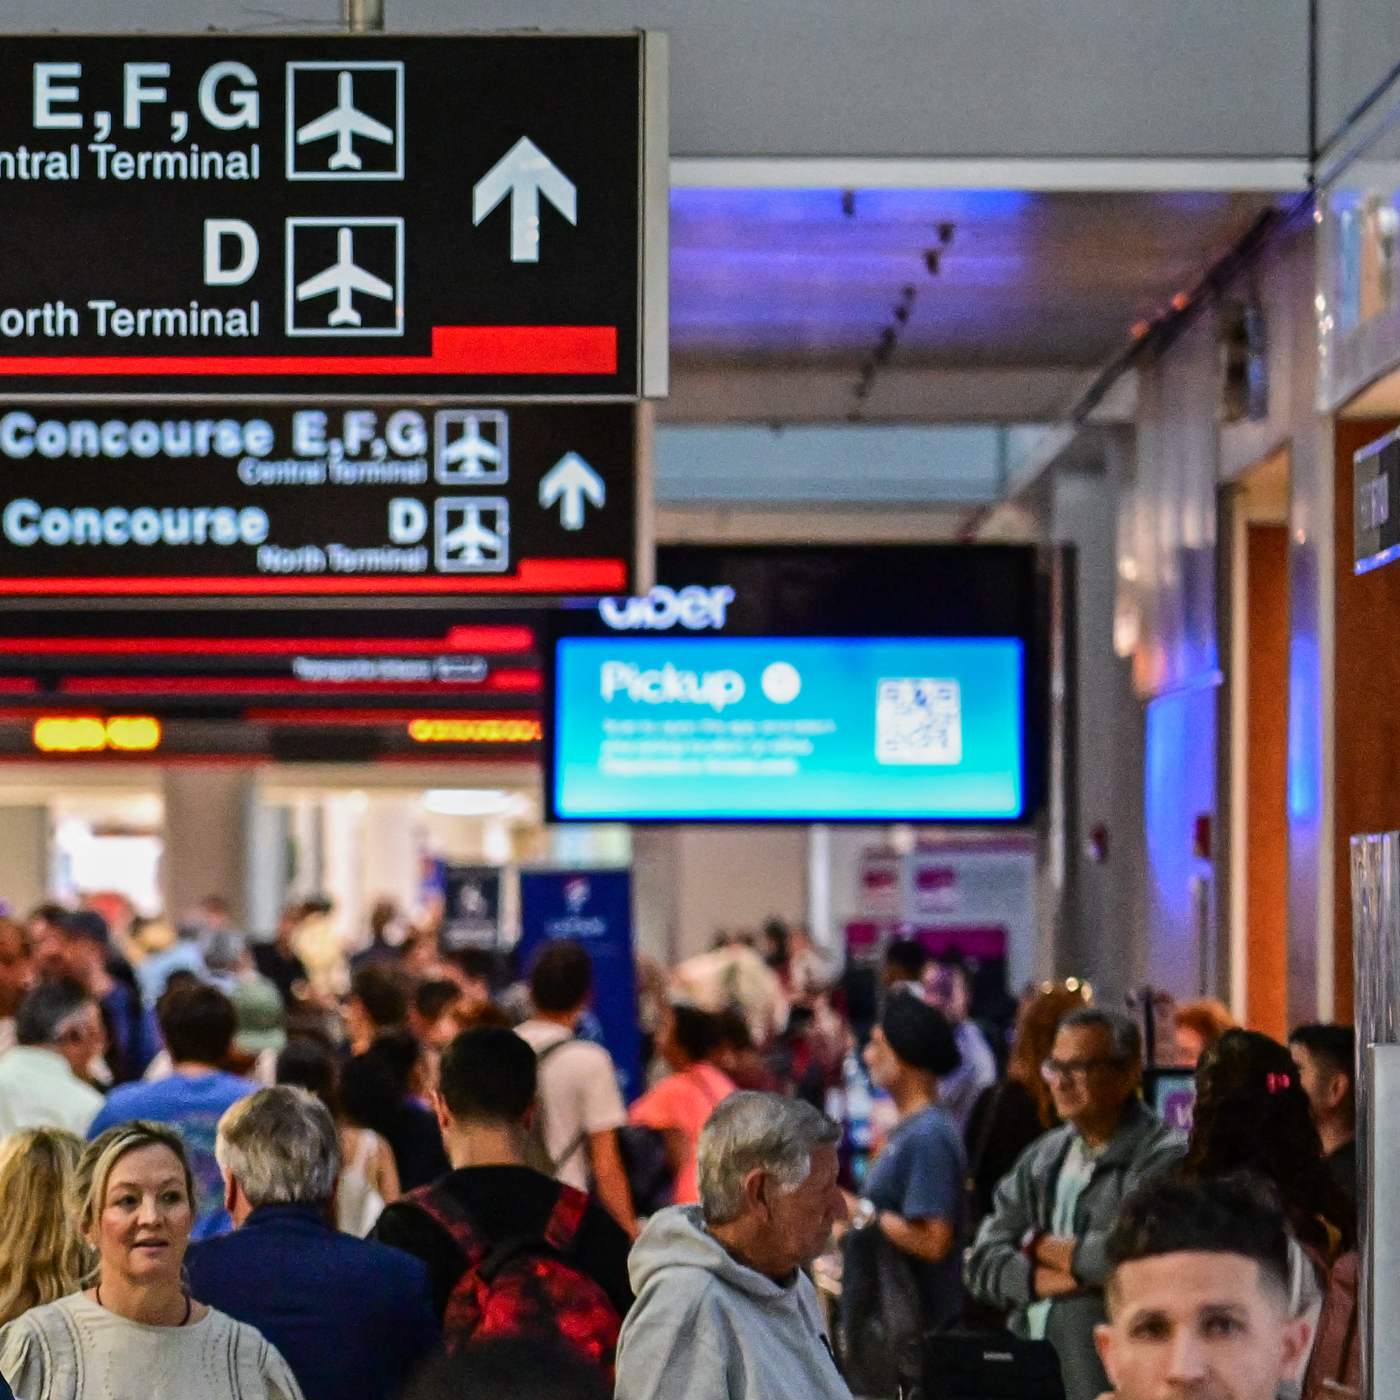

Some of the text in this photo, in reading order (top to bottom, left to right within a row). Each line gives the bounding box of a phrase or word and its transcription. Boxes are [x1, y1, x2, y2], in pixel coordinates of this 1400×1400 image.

[33, 62, 260, 140] E,F,G
[87, 144, 260, 180] Terminal
[204, 218, 260, 286] D
[87, 301, 260, 337] Terminal
[291, 409, 428, 463] E,F,G
[2, 497, 428, 547] Concourse D
[601, 660, 746, 713] Pickup
